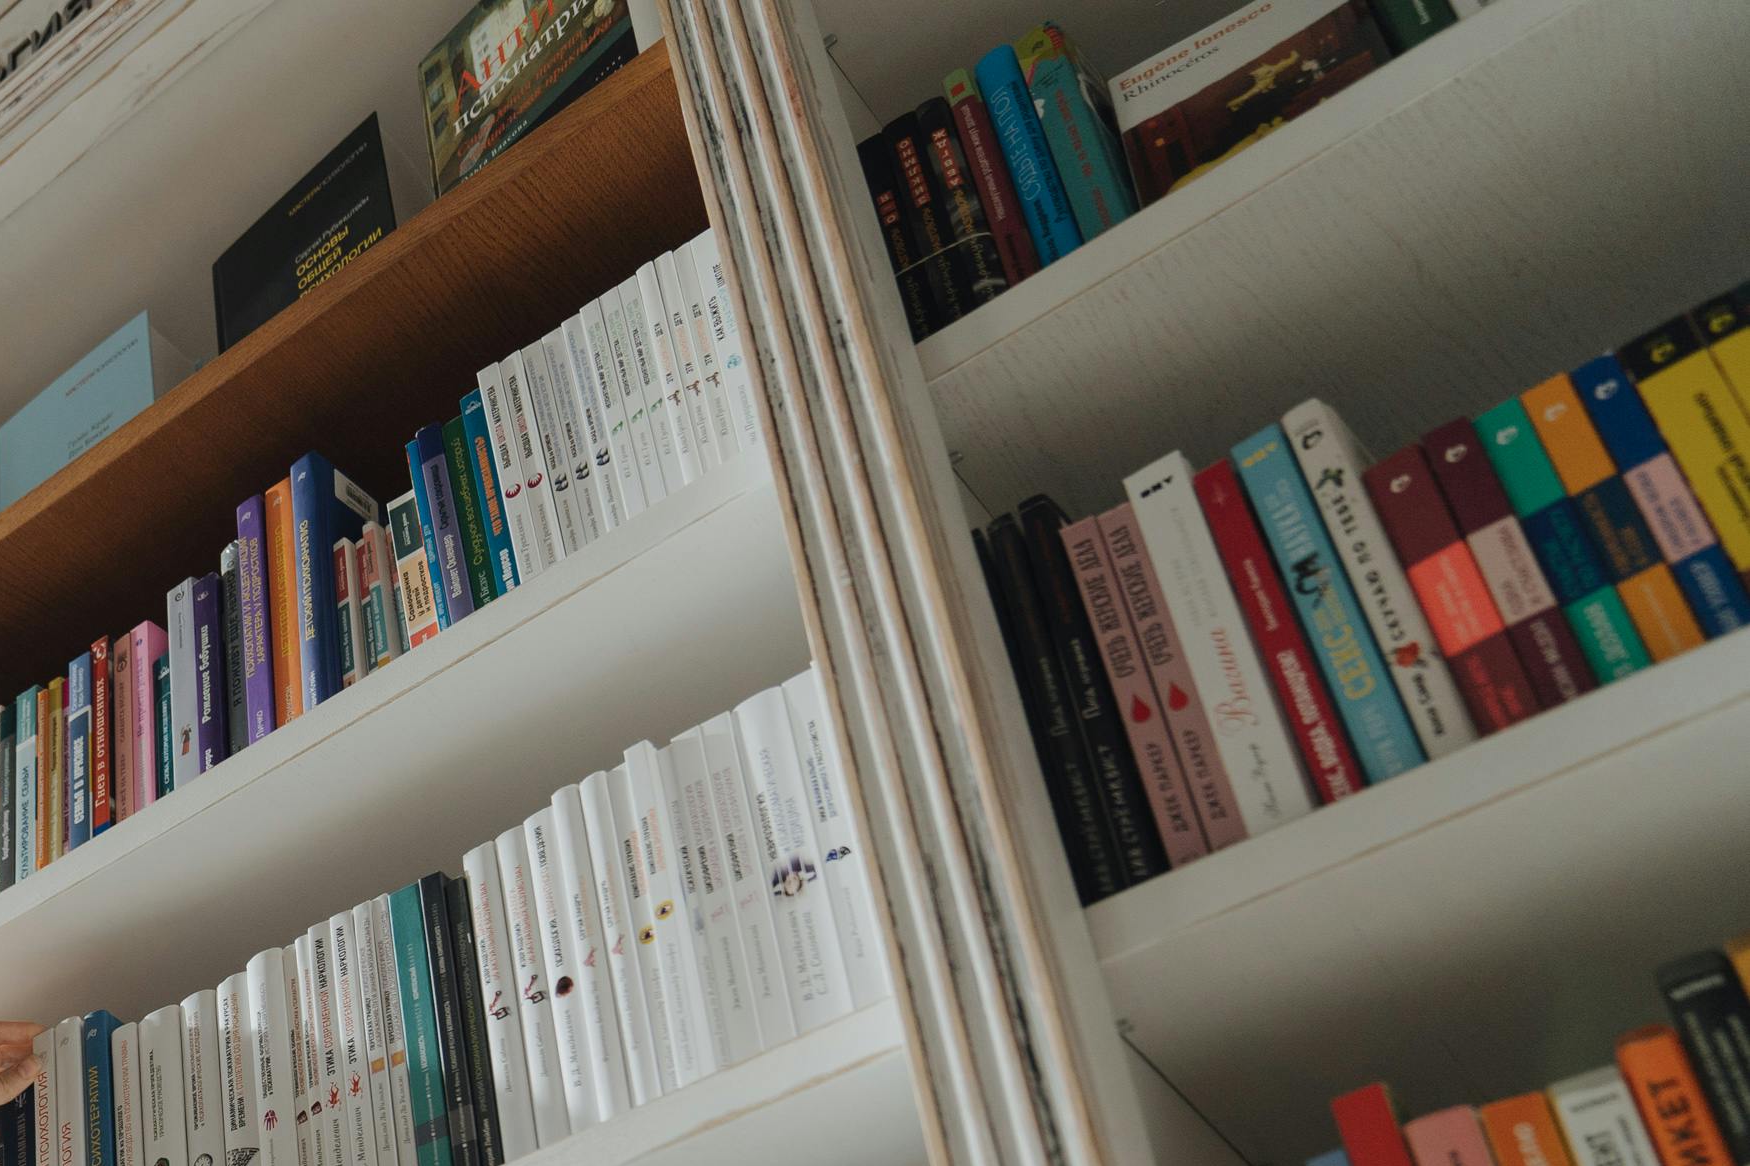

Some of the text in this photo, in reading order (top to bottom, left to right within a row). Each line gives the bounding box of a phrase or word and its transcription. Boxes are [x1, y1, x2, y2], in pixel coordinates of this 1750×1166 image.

[296, 226, 349, 277] ОСНОВЫ
[298, 246, 343, 290] ОБЩЕЙ
[299, 226, 382, 299] ПСИХОЛОГИИ
[712, 262, 725, 287] ШКОЛЕ
[706, 295, 726, 341] КАК ВЫЖИТЬ
[455, 472, 476, 521] волшебных
[486, 497, 503, 536] ЧТО ТАКОЕ
[238, 535, 250, 602] АКЦЕНТУАЦИИ
[249, 537, 261, 599] ПОДРОСТКОВ
[465, 520, 485, 565] Сундучок
[274, 525, 292, 657] ДЕТСТВО И ОБЩЕСТВО
[297, 519, 315, 640] ДЕТСКИЙ ПСИХОАНАЛИЗ
[401, 570, 416, 622] Самооценка
[412, 586, 424, 609] детей
[417, 559, 430, 604] подростков
[242, 611, 255, 678] ПСИХОПАТИИ
[253, 610, 264, 664] ХАРАКТЕРА
[199, 623, 212, 724] Рождение бабушки
[228, 644, 242, 707] Я ПОЖИВУ
[95, 677, 105, 808] Гнев в отношениях
[255, 709, 266, 738] Личко
[21, 766, 29, 797] СЕМЬИ
[73, 789, 84, 824] СЕМЬЯ
[314, 936, 337, 1076] ЭТИКА СОВРЕМЕННОЙ НАРКОЛОГИИ
[334, 924, 358, 1064] ЭТИКА СОВРЕМЕННОЙ НАРКОЛОГИИ
[224, 1035, 238, 1131] ДИНАМИЧЕСКАЯ ПСИХИАТРИЯ
[36, 1071, 50, 1162] ПСИХОЛОГИЯ
[236, 1096, 246, 1127] ВРЕМЕНИ
[352, 1105, 367, 1161] Менделевич
